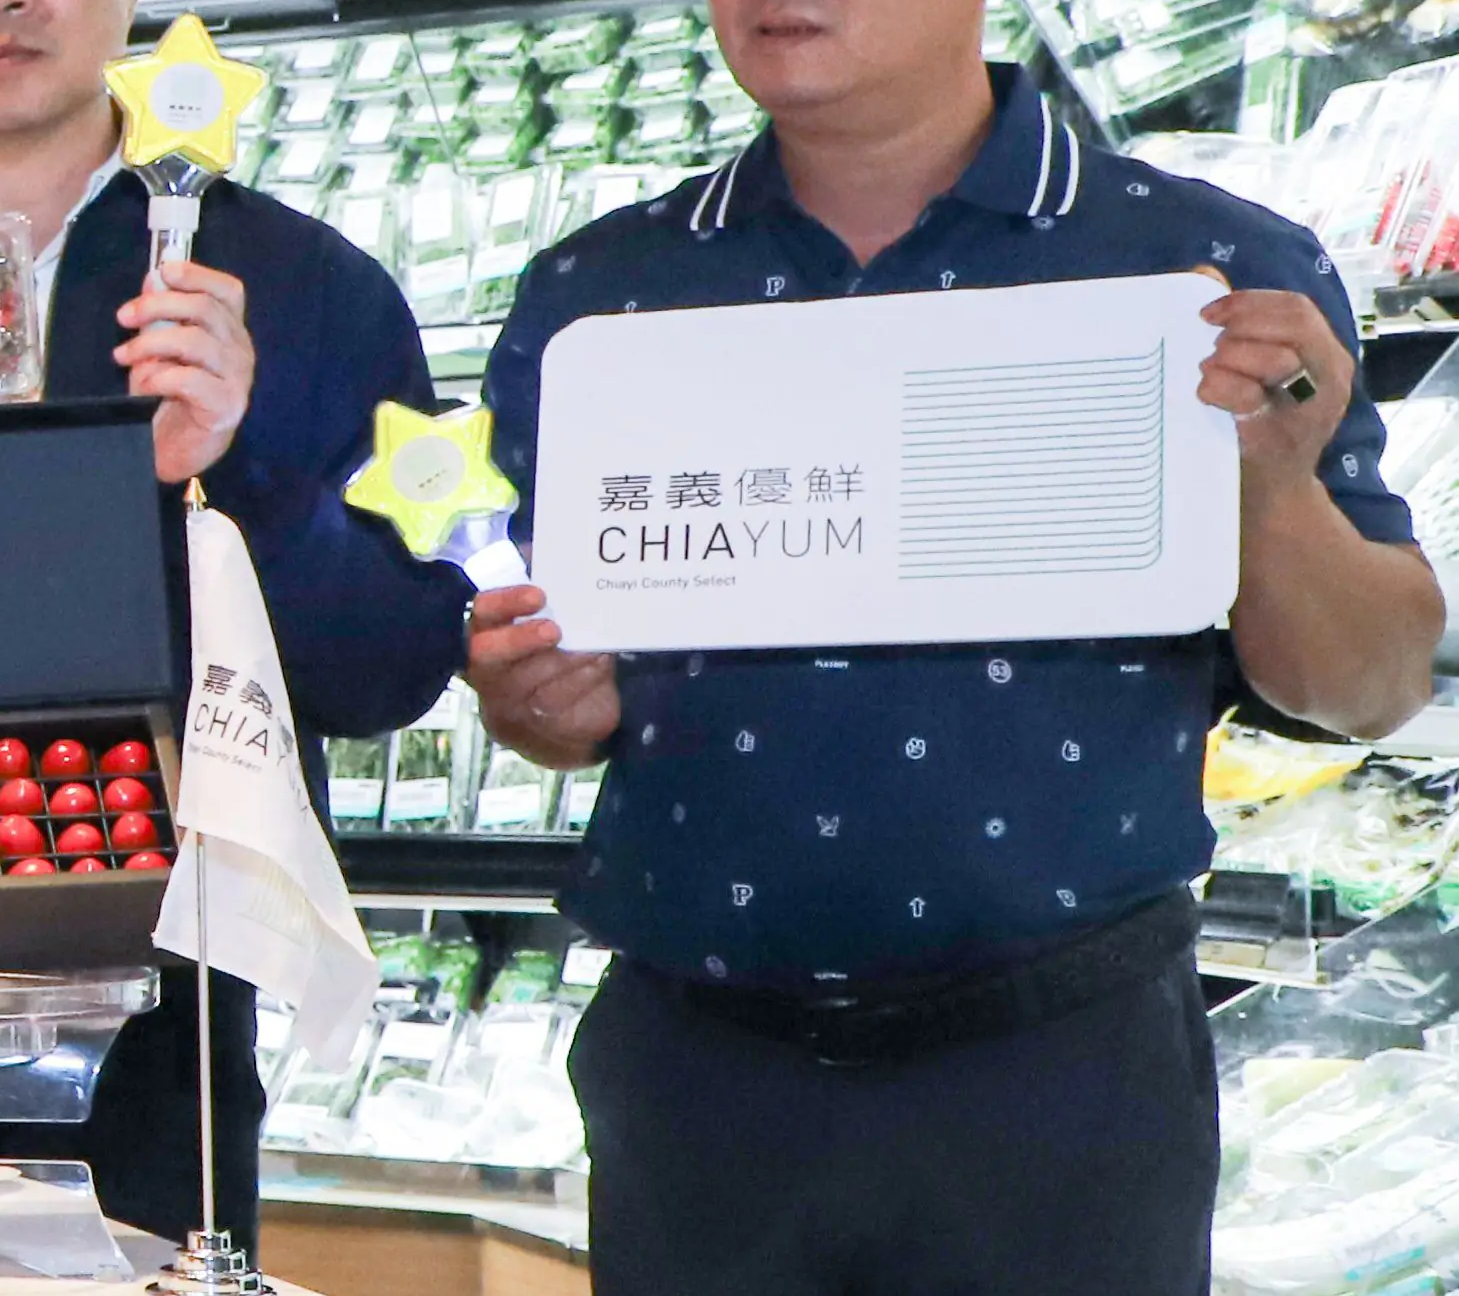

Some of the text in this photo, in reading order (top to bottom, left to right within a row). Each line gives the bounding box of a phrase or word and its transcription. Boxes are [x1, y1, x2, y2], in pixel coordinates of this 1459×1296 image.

[597, 463, 865, 512] 嘉義優鮮
[597, 516, 863, 563] CHIAYUM
[596, 574, 737, 591] Chiayi County Select
